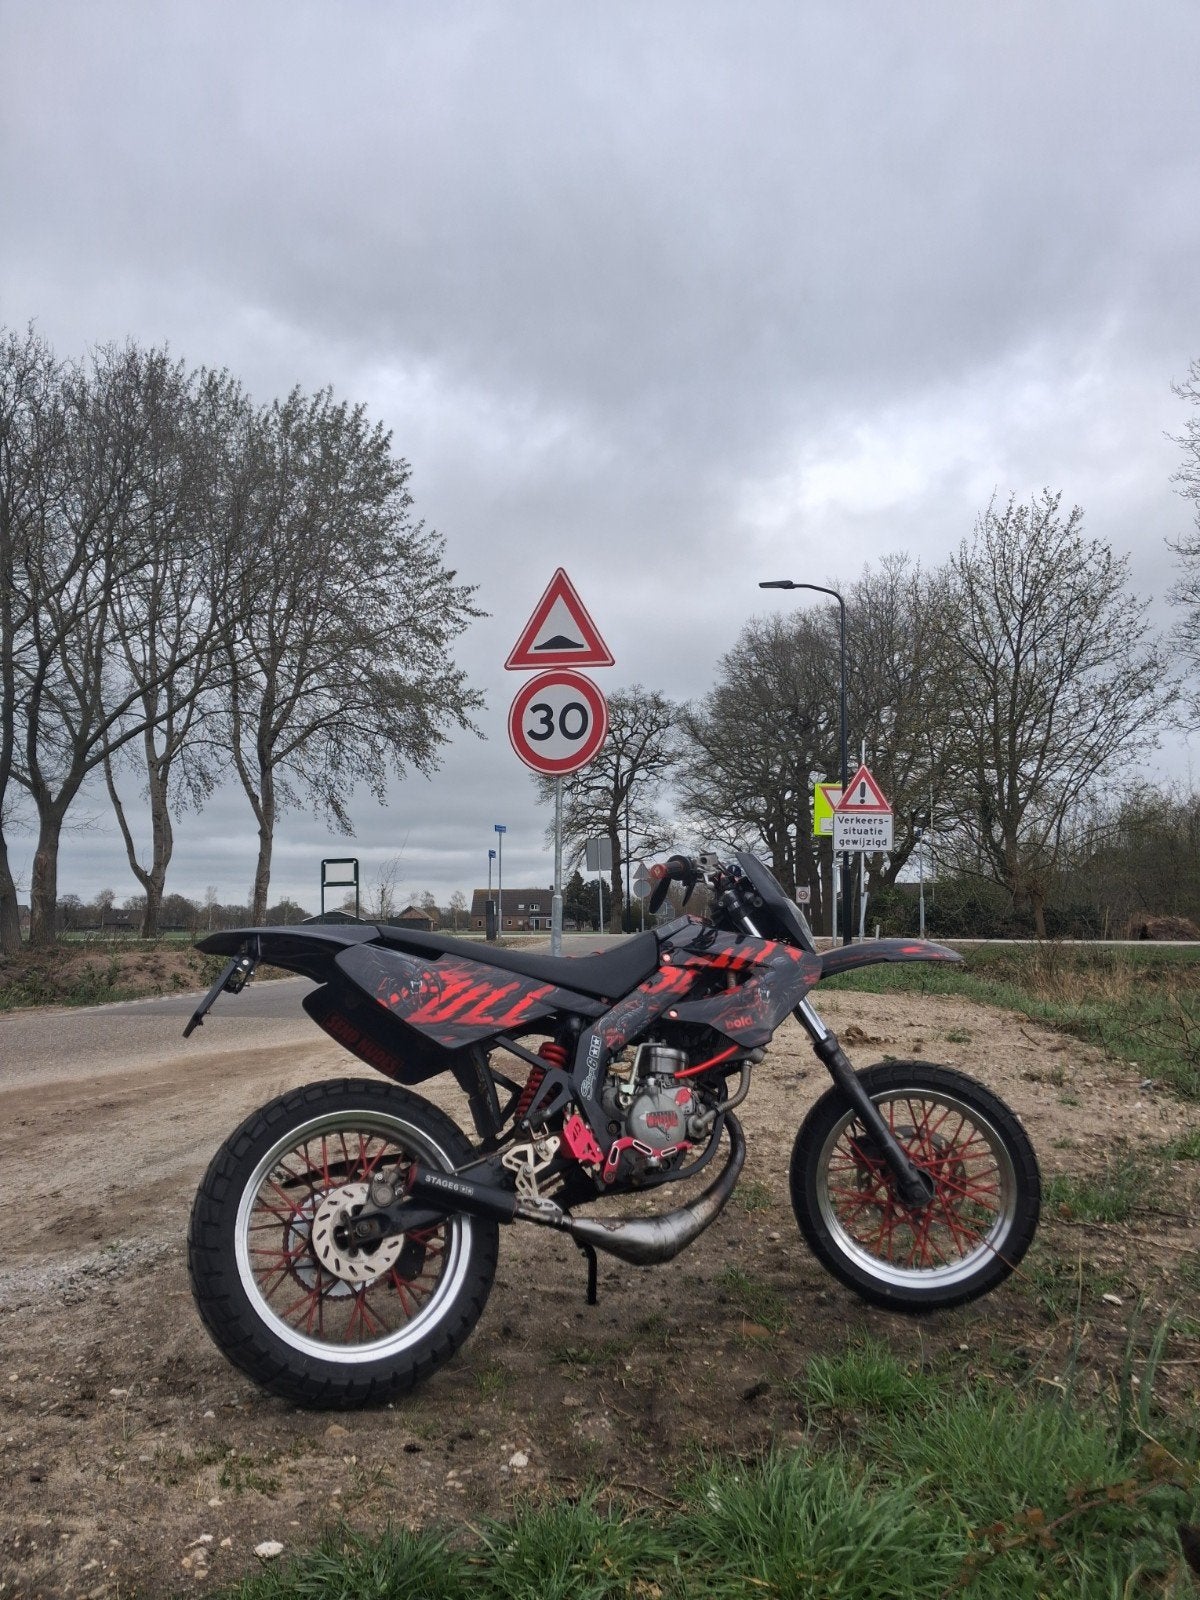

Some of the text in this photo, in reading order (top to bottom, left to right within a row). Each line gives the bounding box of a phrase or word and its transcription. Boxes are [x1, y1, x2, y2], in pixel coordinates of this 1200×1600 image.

[527, 702, 589, 741] 30
[837, 816, 890, 825] Verkeers-
[843, 826, 884, 835] situatie
[838, 838, 888, 848] gewijzigd
[424, 1174, 459, 1192] STAGE6
